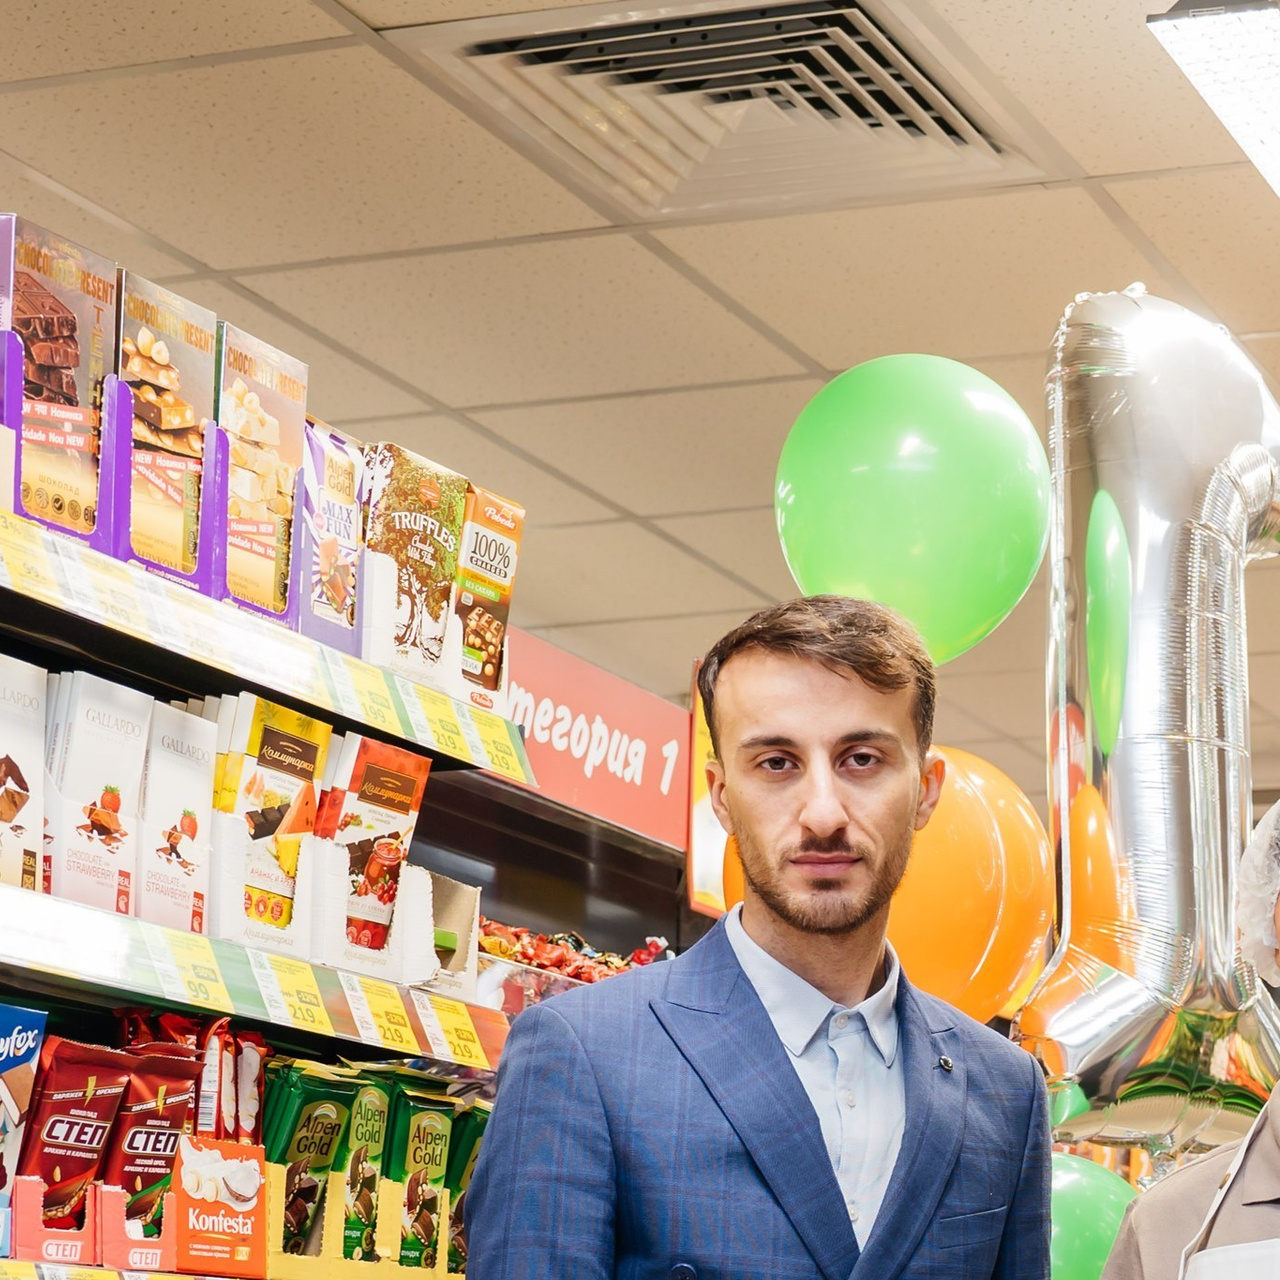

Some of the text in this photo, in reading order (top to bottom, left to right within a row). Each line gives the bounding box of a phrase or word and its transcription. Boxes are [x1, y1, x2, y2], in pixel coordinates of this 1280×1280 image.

[66, 434, 85, 448] NEW
[135, 452, 153, 465] NEW
[326, 456, 355, 485] Alpen
[38, 473, 81, 497] ШОКОЛАД
[328, 474, 352, 499] Gold
[321, 498, 354, 526] MAX
[484, 506, 516, 530] Pobeda
[325, 519, 352, 541] FUN
[390, 509, 457, 554] TRUFFLES
[470, 531, 512, 570] 100%
[470, 555, 507, 579] CHARGED
[85, 707, 142, 738] GALLARDO
[362, 702, 388, 724] 199
[161, 734, 211, 764] GALLARDO
[434, 728, 458, 751] 219
[261, 745, 315, 773] Коммунарка
[489, 750, 511, 771] 219
[659, 738, 680, 796] 1
[362, 782, 413, 805] Коммунарка
[66, 848, 103, 867] CHOCOLATE
[66, 859, 116, 882] STRAWBERRY
[145, 869, 181, 888] CHOCOLATE
[144, 880, 192, 902] STRAWBERRY
[186, 979, 211, 1003] 99
[288, 1003, 316, 1026] 219
[378, 1024, 405, 1046] 219
[448, 1040, 474, 1060] 219
[299, 1111, 342, 1138] Alpen
[354, 1102, 386, 1125] Alpen
[45, 1118, 109, 1147] СТЕП
[126, 1129, 180, 1153] СТЕП
[355, 1123, 381, 1144] Gold
[411, 1123, 448, 1147] Alpen
[296, 1134, 334, 1156] Gold
[412, 1146, 442, 1167] Gold
[188, 1207, 253, 1236] Konfesta
[44, 1242, 80, 1259] СТЕП
[130, 1250, 160, 1267] СТЕП
